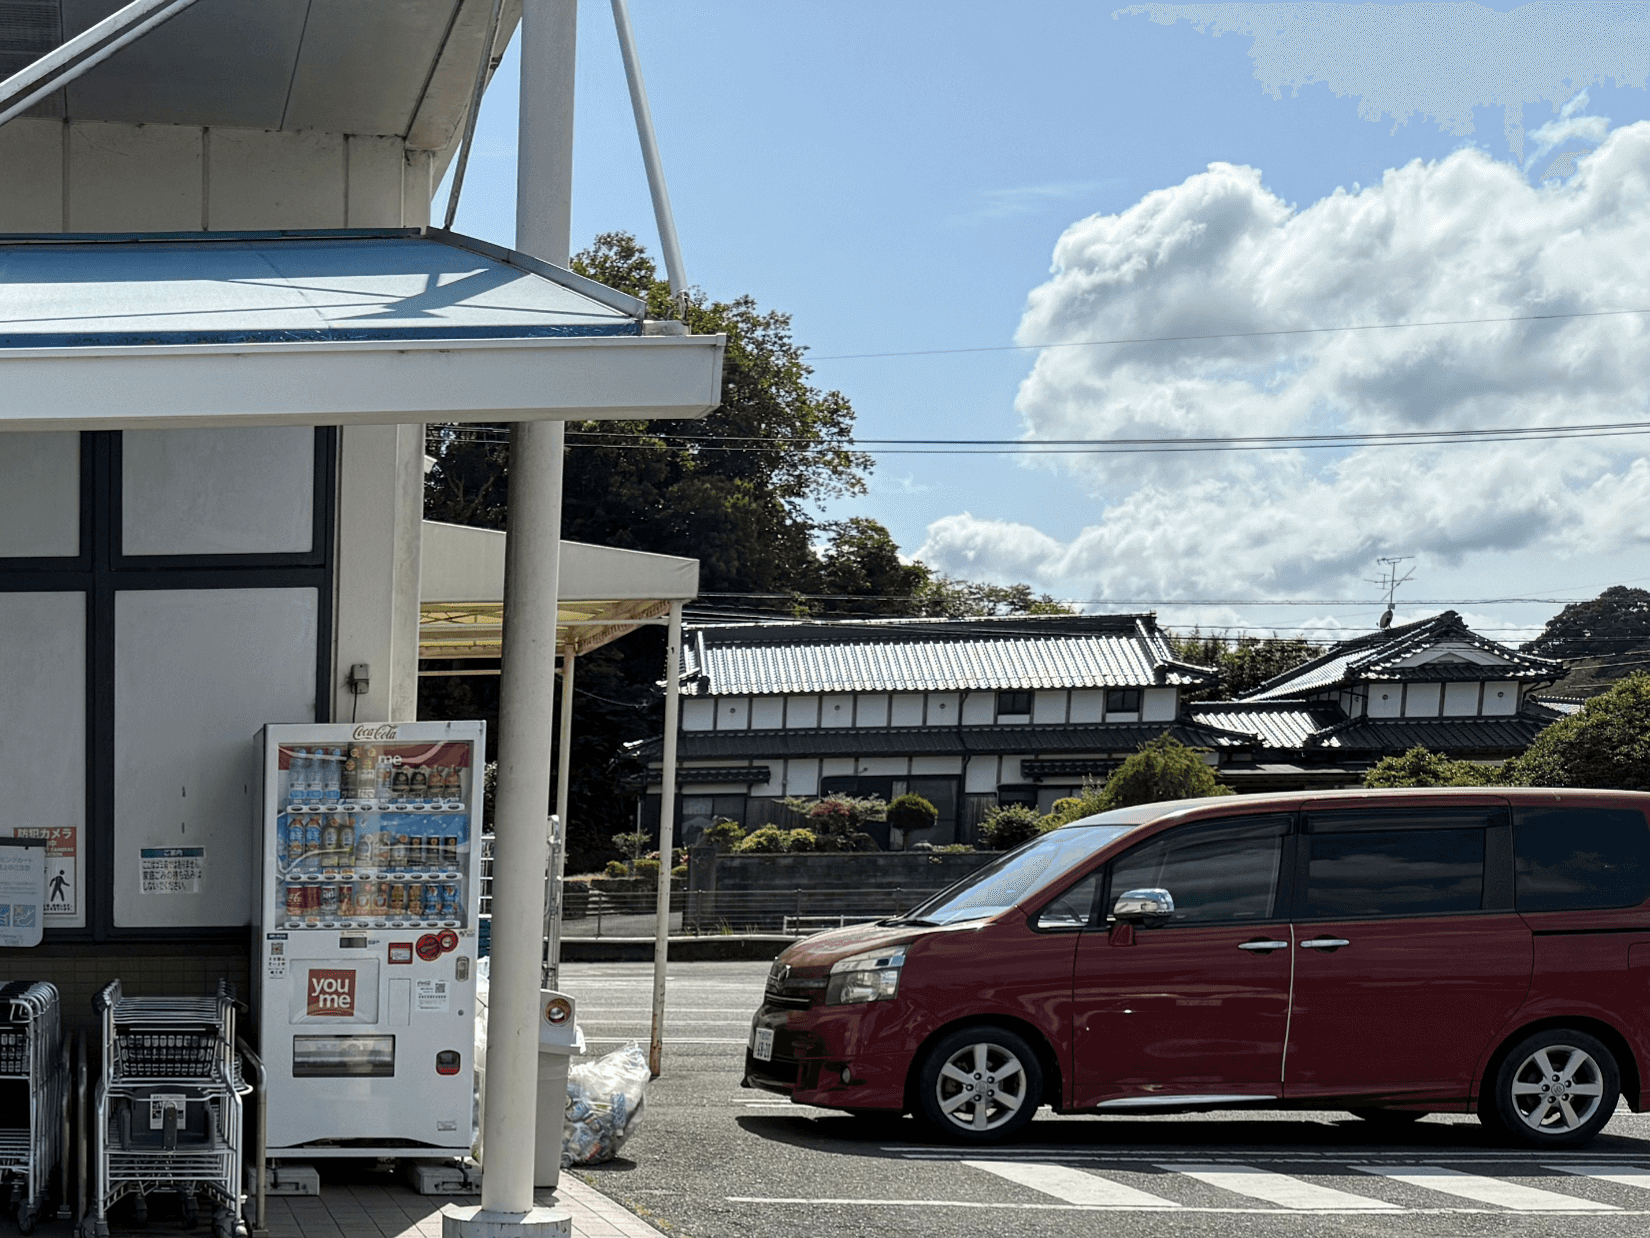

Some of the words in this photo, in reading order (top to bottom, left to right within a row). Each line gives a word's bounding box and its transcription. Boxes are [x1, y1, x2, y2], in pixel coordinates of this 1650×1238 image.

[353, 724, 399, 741] Coca-Cola
[378, 755, 402, 765] me
[17, 827, 72, 839] 防犯カメラ
[311, 978, 349, 997] you
[319, 994, 351, 1008] me
